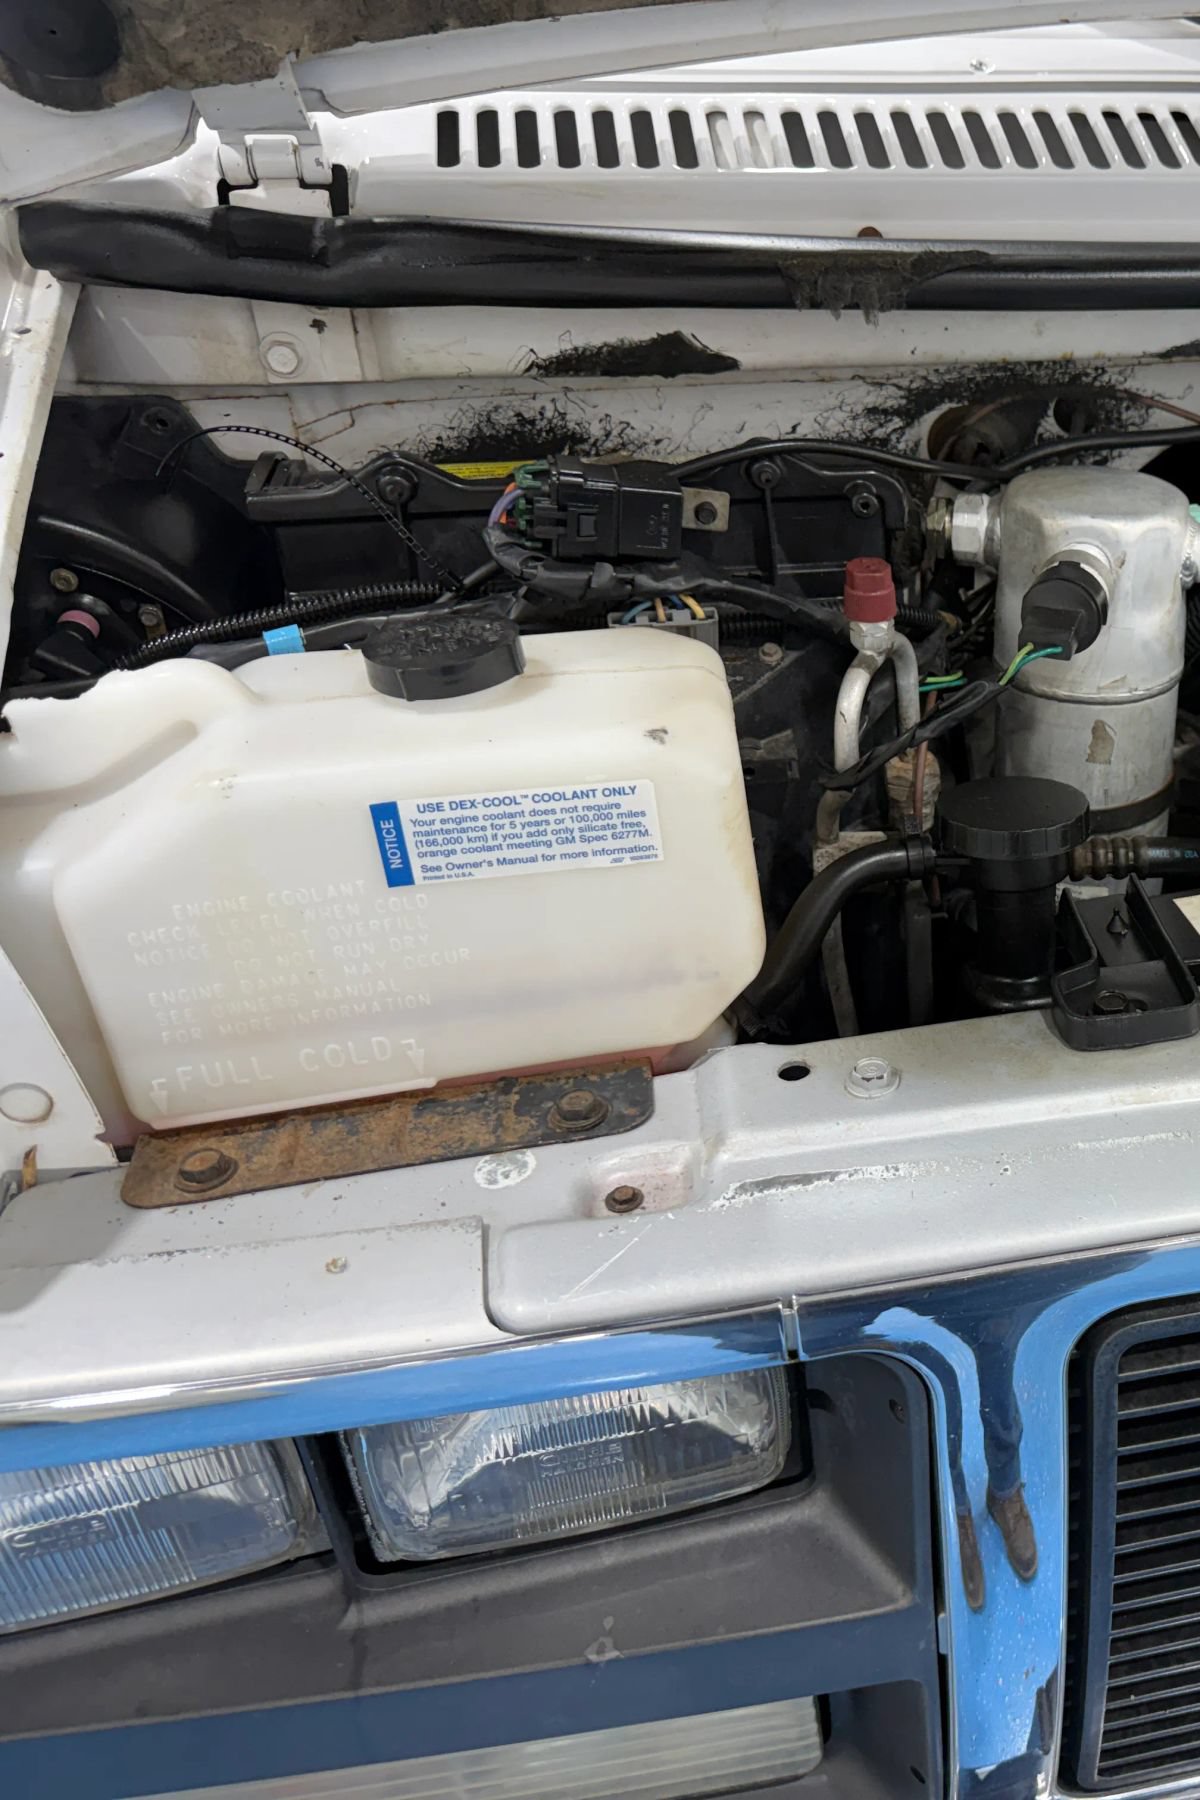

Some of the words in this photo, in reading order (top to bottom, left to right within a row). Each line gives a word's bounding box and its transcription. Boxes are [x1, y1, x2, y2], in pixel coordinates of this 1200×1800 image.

[410, 818, 437, 828] Your
[439, 815, 480, 826] engine
[482, 809, 526, 821] coolant
[528, 807, 557, 817] does
[560, 804, 579, 815] not
[581, 801, 622, 814] require
[416, 802, 446, 814] USE
[531, 788, 598, 804] COOLANT
[601, 785, 637, 798] ONLY
[412, 825, 488, 838] maintenance
[490, 822, 506, 832] for
[509, 820, 517, 830] 5
[520, 818, 551, 830] years
[553, 817, 566, 826] or
[569, 811, 614, 824] 100,000
[616, 810, 647, 820] miles
[415, 836, 464, 851] (166,000
[466, 835, 489, 845] km)
[491, 832, 498, 841] if
[501, 831, 523, 843] you
[526, 829, 548, 838] add
[550, 826, 575, 837] only
[577, 822, 618, 834] silicate
[620, 819, 646, 829] free,
[417, 848, 458, 859] orange
[460, 843, 504, 855] coolant
[506, 838, 553, 850] meeting
[555, 836, 577, 846] GM
[579, 833, 609, 844] Spec
[611, 828, 653, 840] 6277M.
[380, 818, 404, 870] NOTICE
[420, 864, 443, 874] See
[445, 859, 494, 872] Owner's
[496, 854, 539, 866] Manual
[541, 852, 557, 862] for
[560, 850, 589, 861] more
[591, 843, 658, 857] information.
[422, 873, 446, 881] Printed
[127, 923, 201, 947] CHECK
[216, 913, 288, 937] LEVEL
[303, 902, 361, 922] WHEN
[375, 892, 429, 913] COLD
[170, 895, 249, 922] ENGINE
[266, 879, 365, 907] COOLANT
[134, 943, 213, 968] NOTICE
[269, 928, 310, 947] NOT
[327, 914, 429, 942] OVERFILL
[275, 949, 315, 968] NOT
[333, 942, 376, 959] RUN
[389, 933, 429, 952] DRY
[147, 983, 225, 1009] ENGINE
[239, 968, 329, 995] DAMAGE
[343, 959, 387, 977] MAY
[403, 947, 472, 971] OCCUR
[156, 1008, 200, 1027] SEE
[211, 991, 300, 1019] OWNERS
[313, 977, 401, 1001] MANUAL
[161, 1026, 204, 1046] FOR
[217, 1015, 277, 1038] MORE
[289, 992, 432, 1025] INFORMATION
[175, 1055, 273, 1093] FULL
[299, 1035, 392, 1073] COLD
